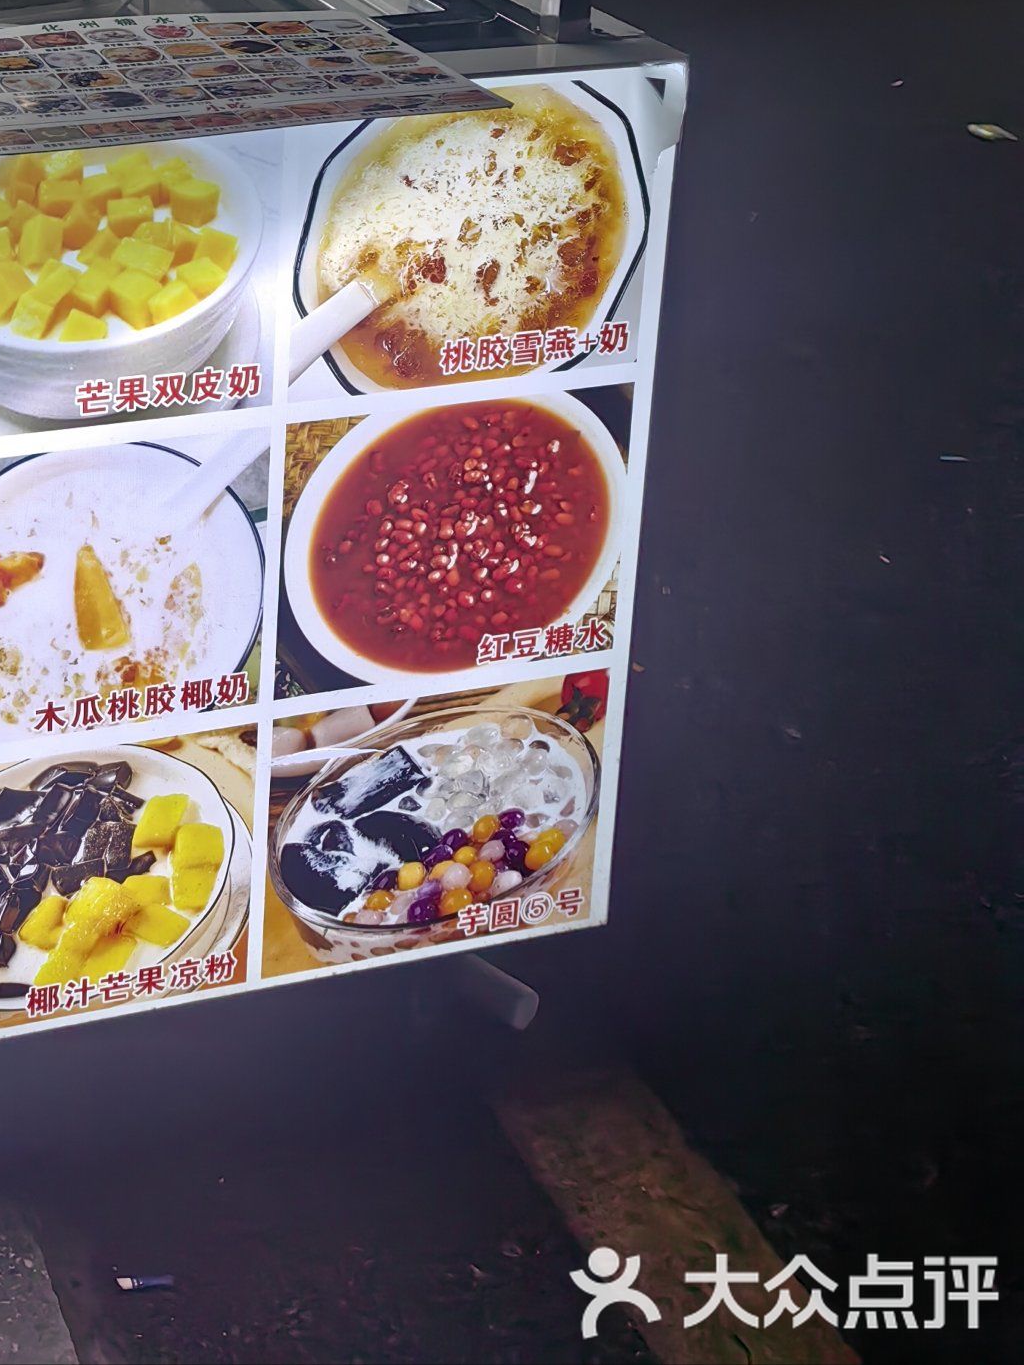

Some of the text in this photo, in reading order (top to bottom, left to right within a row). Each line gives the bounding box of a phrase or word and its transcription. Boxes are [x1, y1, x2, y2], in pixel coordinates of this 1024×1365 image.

[41, 14, 210, 33] 化州糖水店
[440, 321, 629, 375] 桃胶雪燕+奶
[76, 363, 262, 417] 芒果双皮奶
[477, 618, 608, 665] 红豆糖水
[34, 671, 250, 734] 木瓜桃胶椰奶
[25, 948, 238, 1018] 椰汁芒果凉粉
